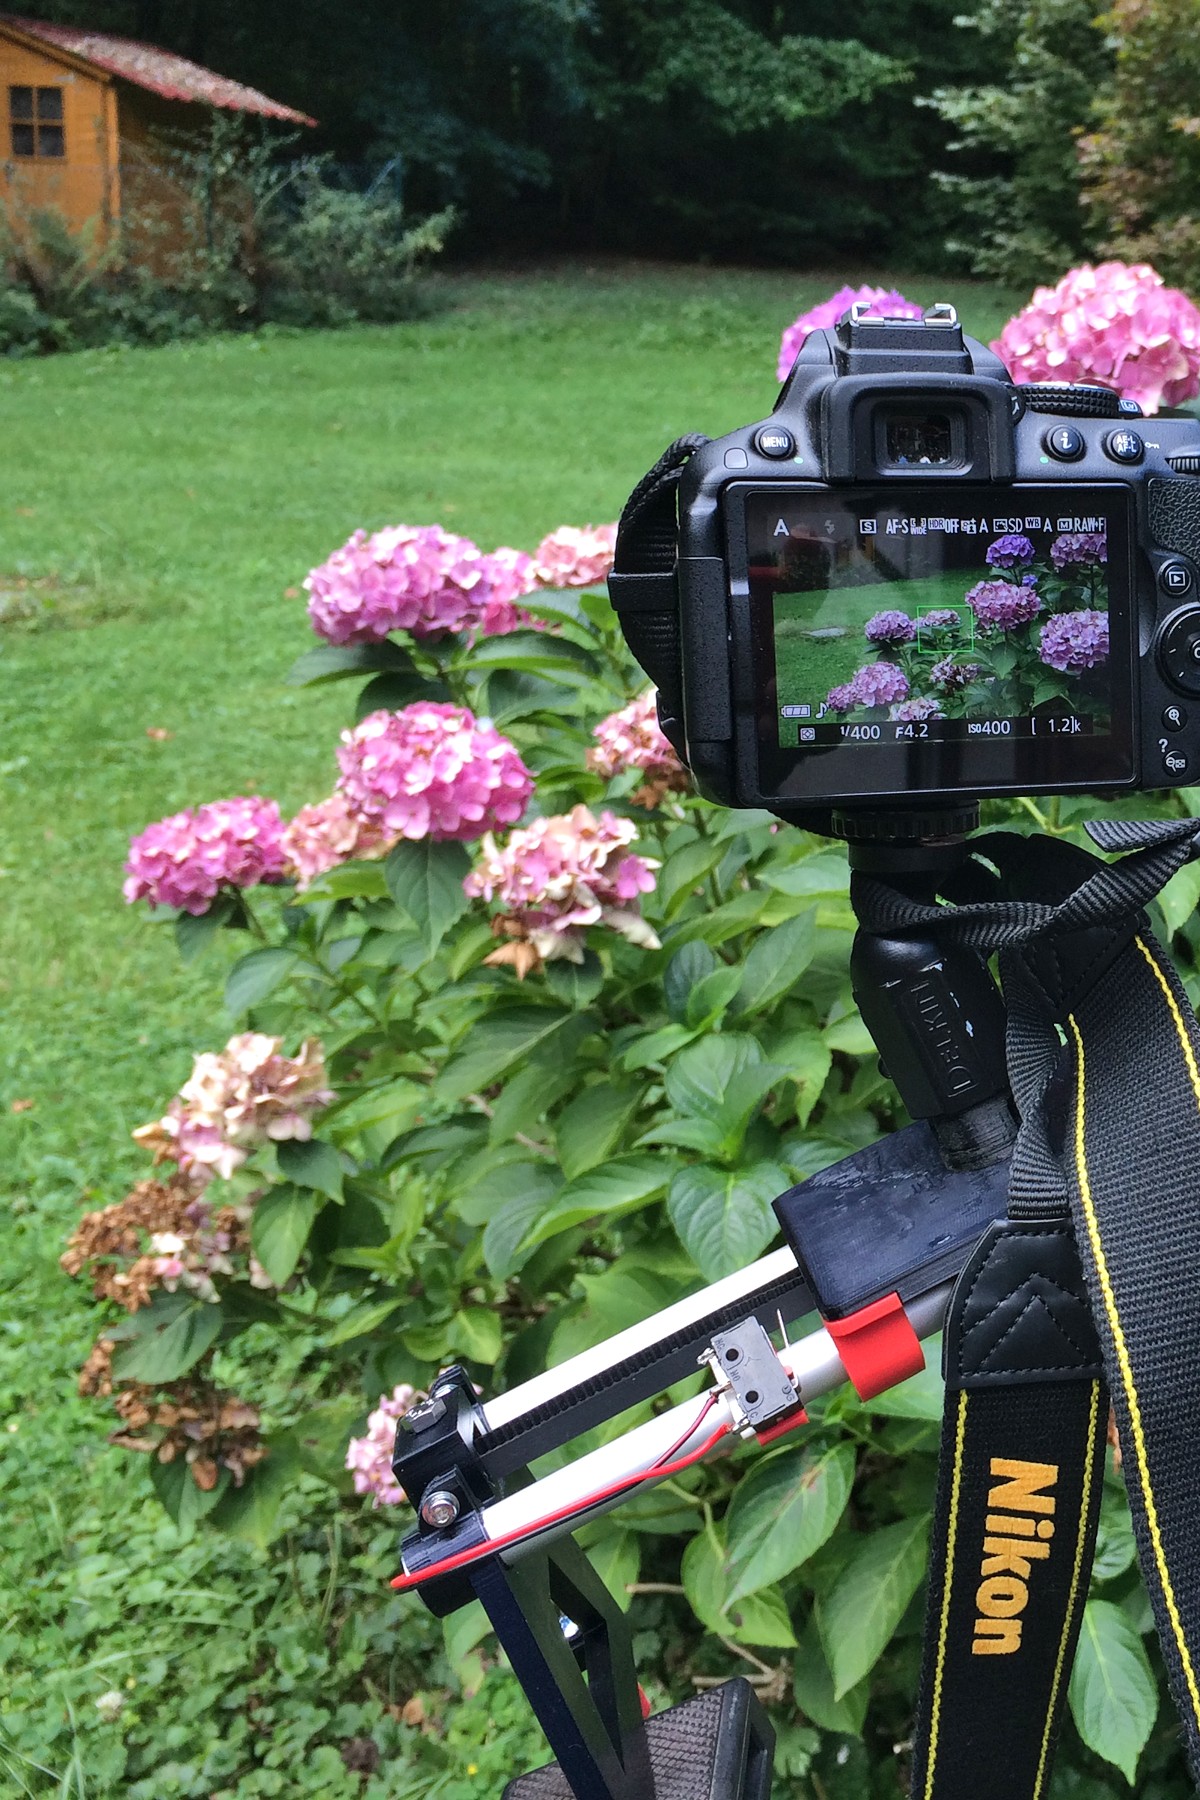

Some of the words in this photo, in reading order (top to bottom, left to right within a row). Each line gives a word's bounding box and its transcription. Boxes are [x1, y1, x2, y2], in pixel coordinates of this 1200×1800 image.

[762, 436, 788, 448] MENU
[773, 518, 790, 537] A
[885, 518, 909, 535] AF-S
[944, 518, 959, 534] OFF
[979, 518, 989, 533] A
[1008, 518, 1023, 533] SD
[1026, 517, 1041, 529] WB
[1043, 518, 1053, 533] A
[840, 725, 881, 740] 1/400
[895, 723, 929, 738] F4.2
[968, 720, 1011, 735] ISO400
[971, 1457, 1059, 1655] Nikon
